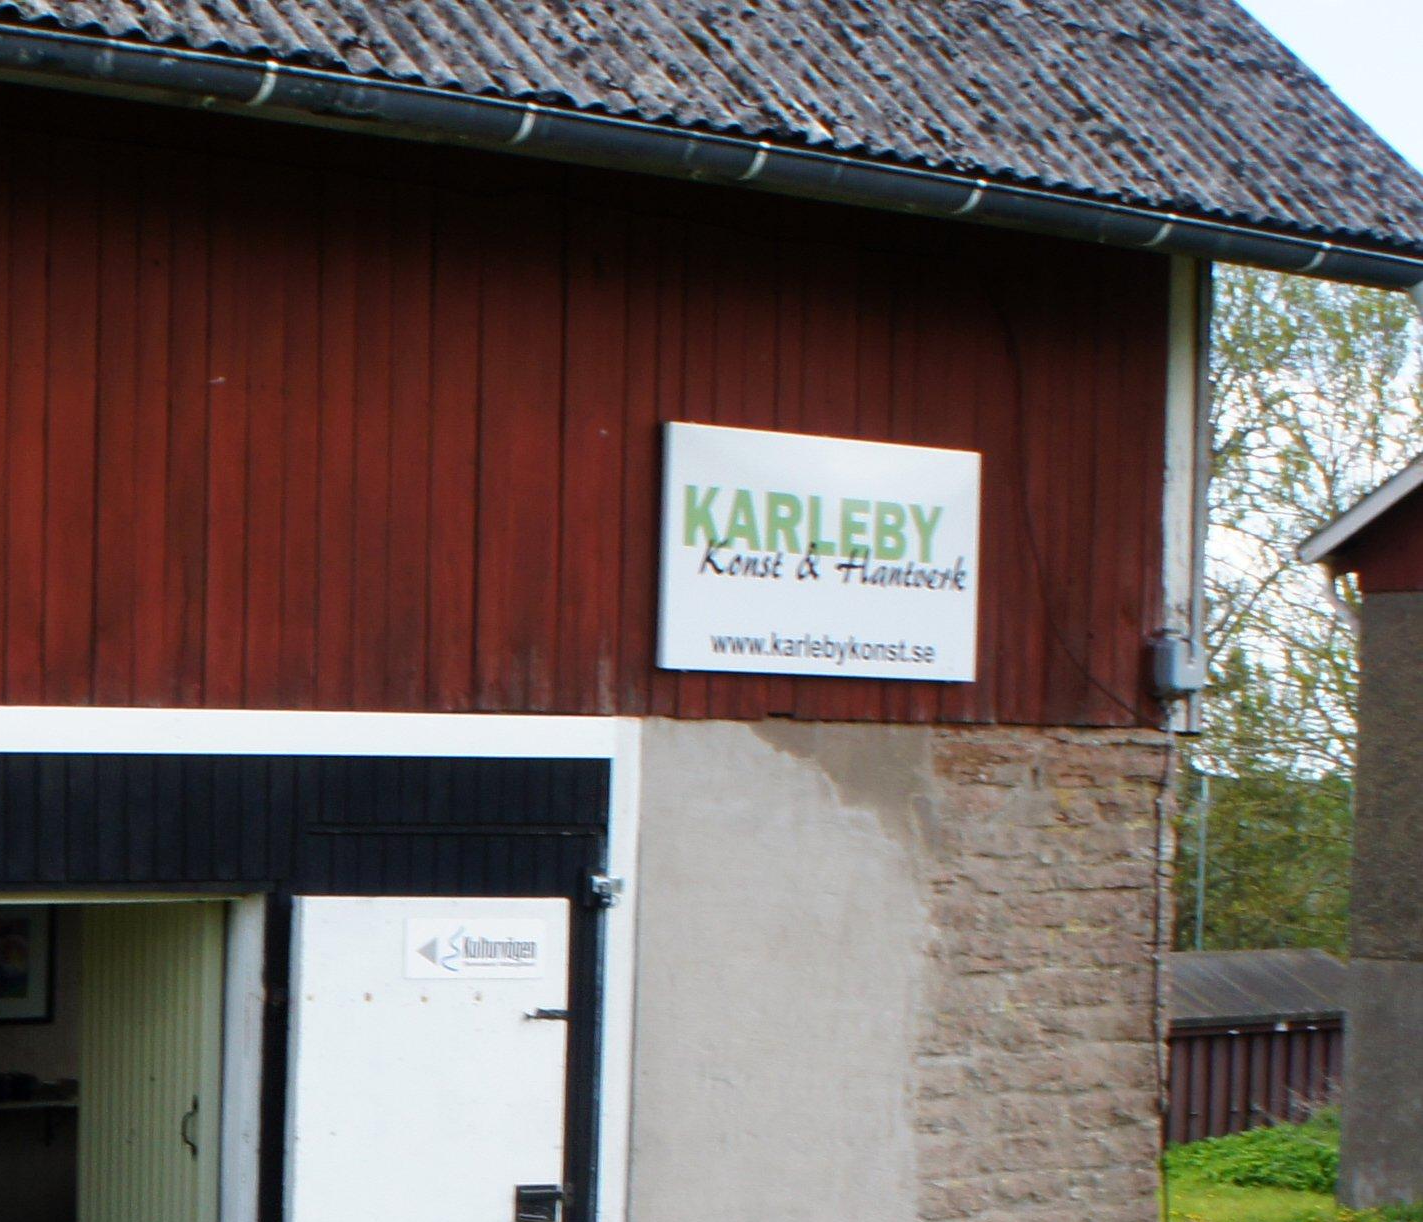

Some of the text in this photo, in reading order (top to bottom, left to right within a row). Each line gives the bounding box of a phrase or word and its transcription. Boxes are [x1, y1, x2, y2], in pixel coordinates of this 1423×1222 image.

[683, 484, 943, 563] KARLEBY
[698, 538, 967, 592] Konst & Hantverk
[710, 632, 935, 665] www.karlebykonst.se
